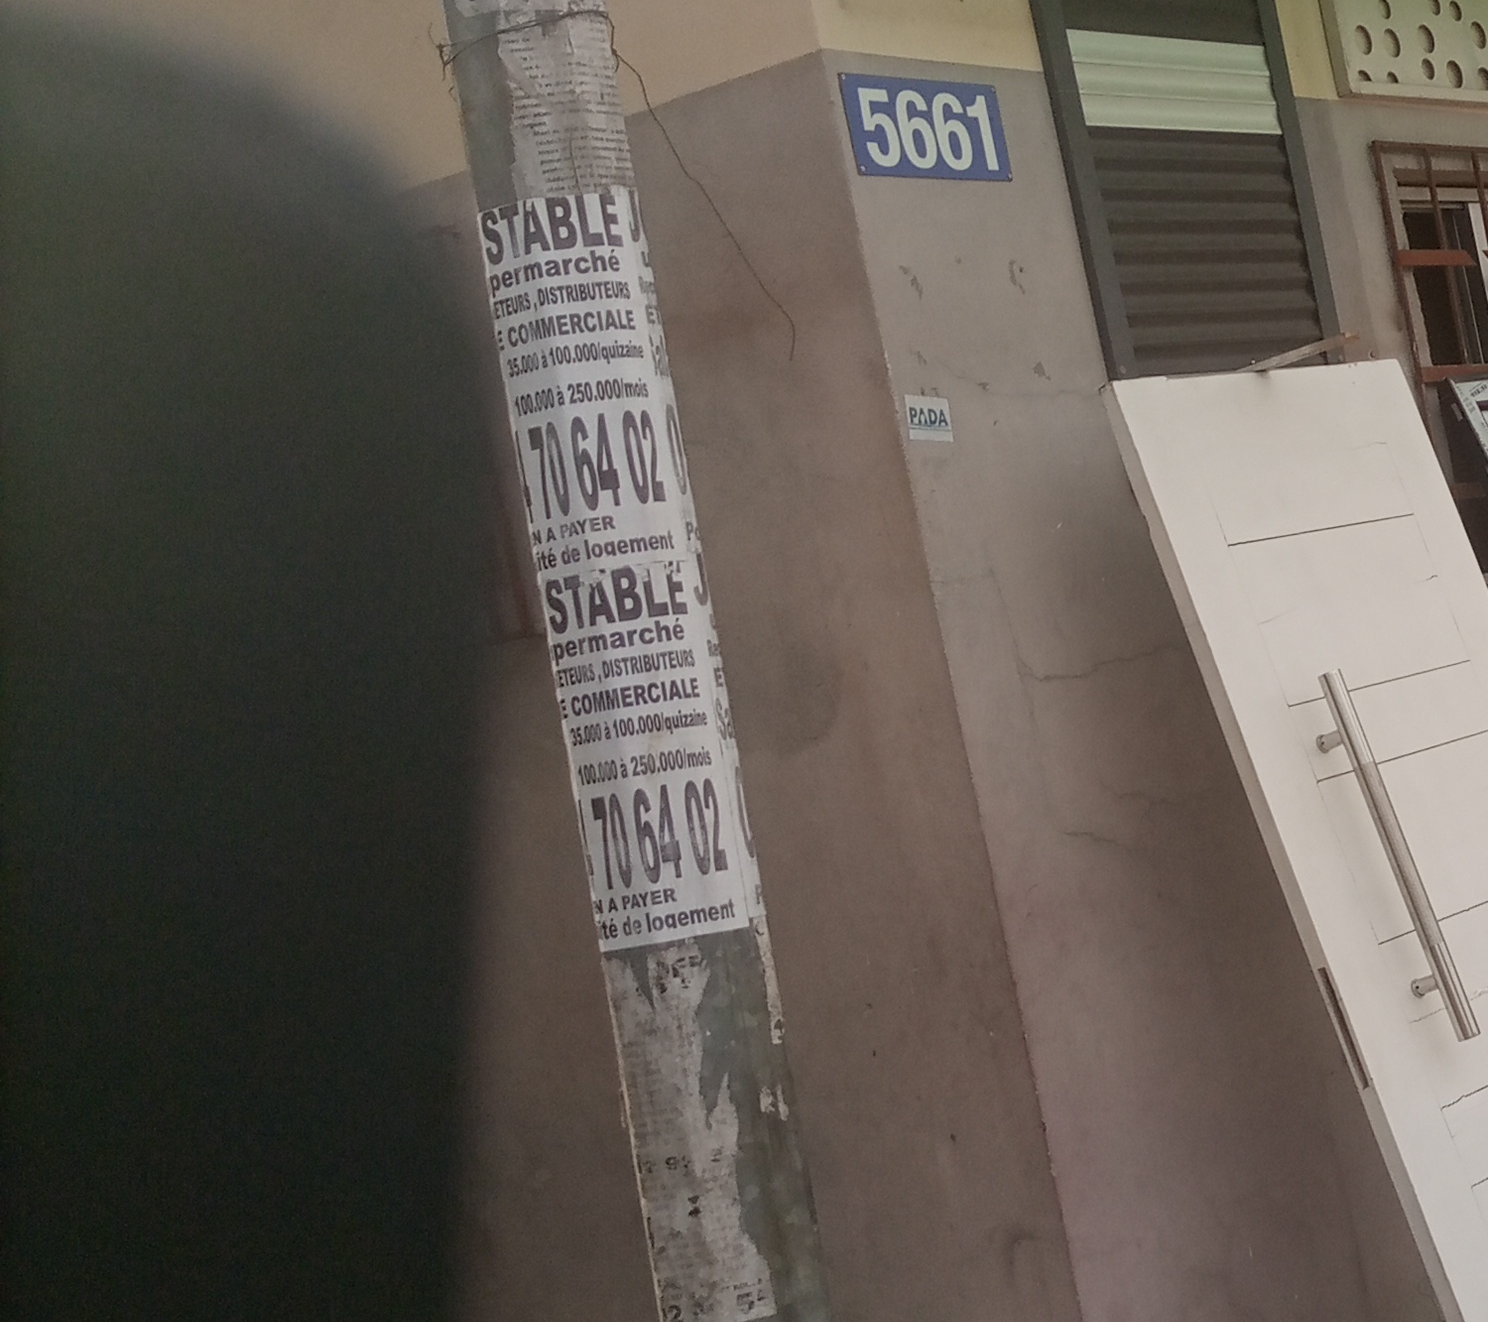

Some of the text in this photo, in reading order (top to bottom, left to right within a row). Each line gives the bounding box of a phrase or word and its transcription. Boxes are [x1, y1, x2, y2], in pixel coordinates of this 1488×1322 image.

[857, 87, 1000, 172] 5661
[480, 191, 624, 266] STABLE
[490, 249, 621, 299] permarché
[507, 309, 637, 348] COMMERCIALE
[507, 352, 539, 378] 35.000
[541, 348, 549, 369] à
[515, 387, 555, 417] 100.000
[556, 385, 565, 407] à
[908, 406, 949, 428] PADA
[528, 421, 571, 520] 70
[571, 412, 622, 512] 64
[622, 409, 667, 505] 02
[560, 515, 616, 538] PAYER
[561, 541, 581, 565] de
[545, 563, 689, 635] STABLE
[571, 677, 701, 718] COMMERCIALE
[570, 723, 602, 747] 35.000
[604, 720, 611, 741] à
[577, 759, 618, 787] 100.000
[620, 756, 628, 778] à
[591, 777, 729, 891] 70 64 02
[621, 887, 678, 910] PAYER
[621, 914, 642, 936] de
